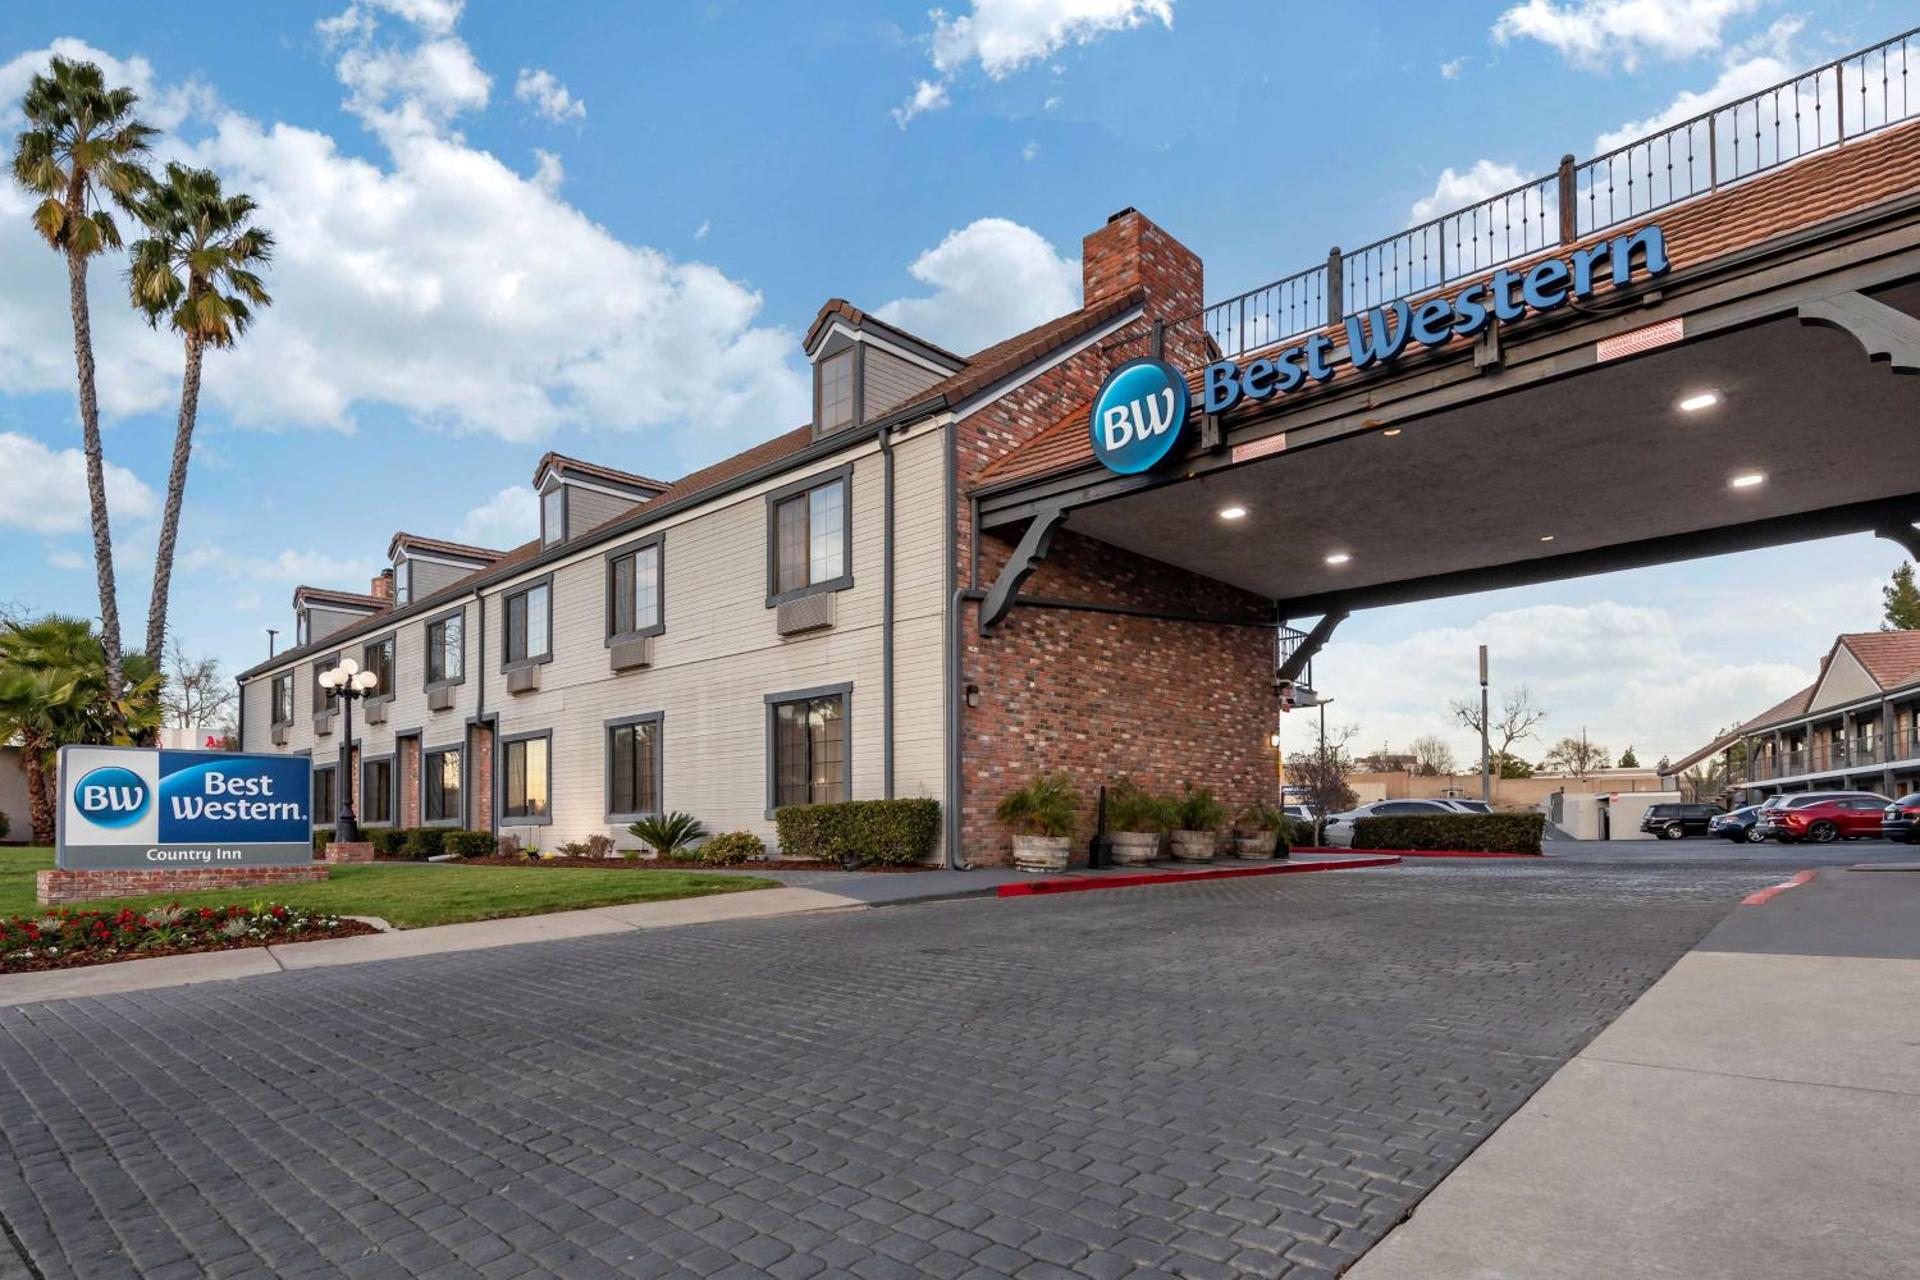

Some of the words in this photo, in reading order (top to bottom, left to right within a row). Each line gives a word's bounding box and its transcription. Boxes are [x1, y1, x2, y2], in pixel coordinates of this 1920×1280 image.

[1204, 334, 1336, 415] Best
[1344, 223, 1671, 370] Western
[1103, 387, 1175, 451] BW
[205, 771, 273, 796] Best
[83, 785, 144, 811] BW
[146, 848, 211, 862] Country
[216, 848, 242, 860] Inn
